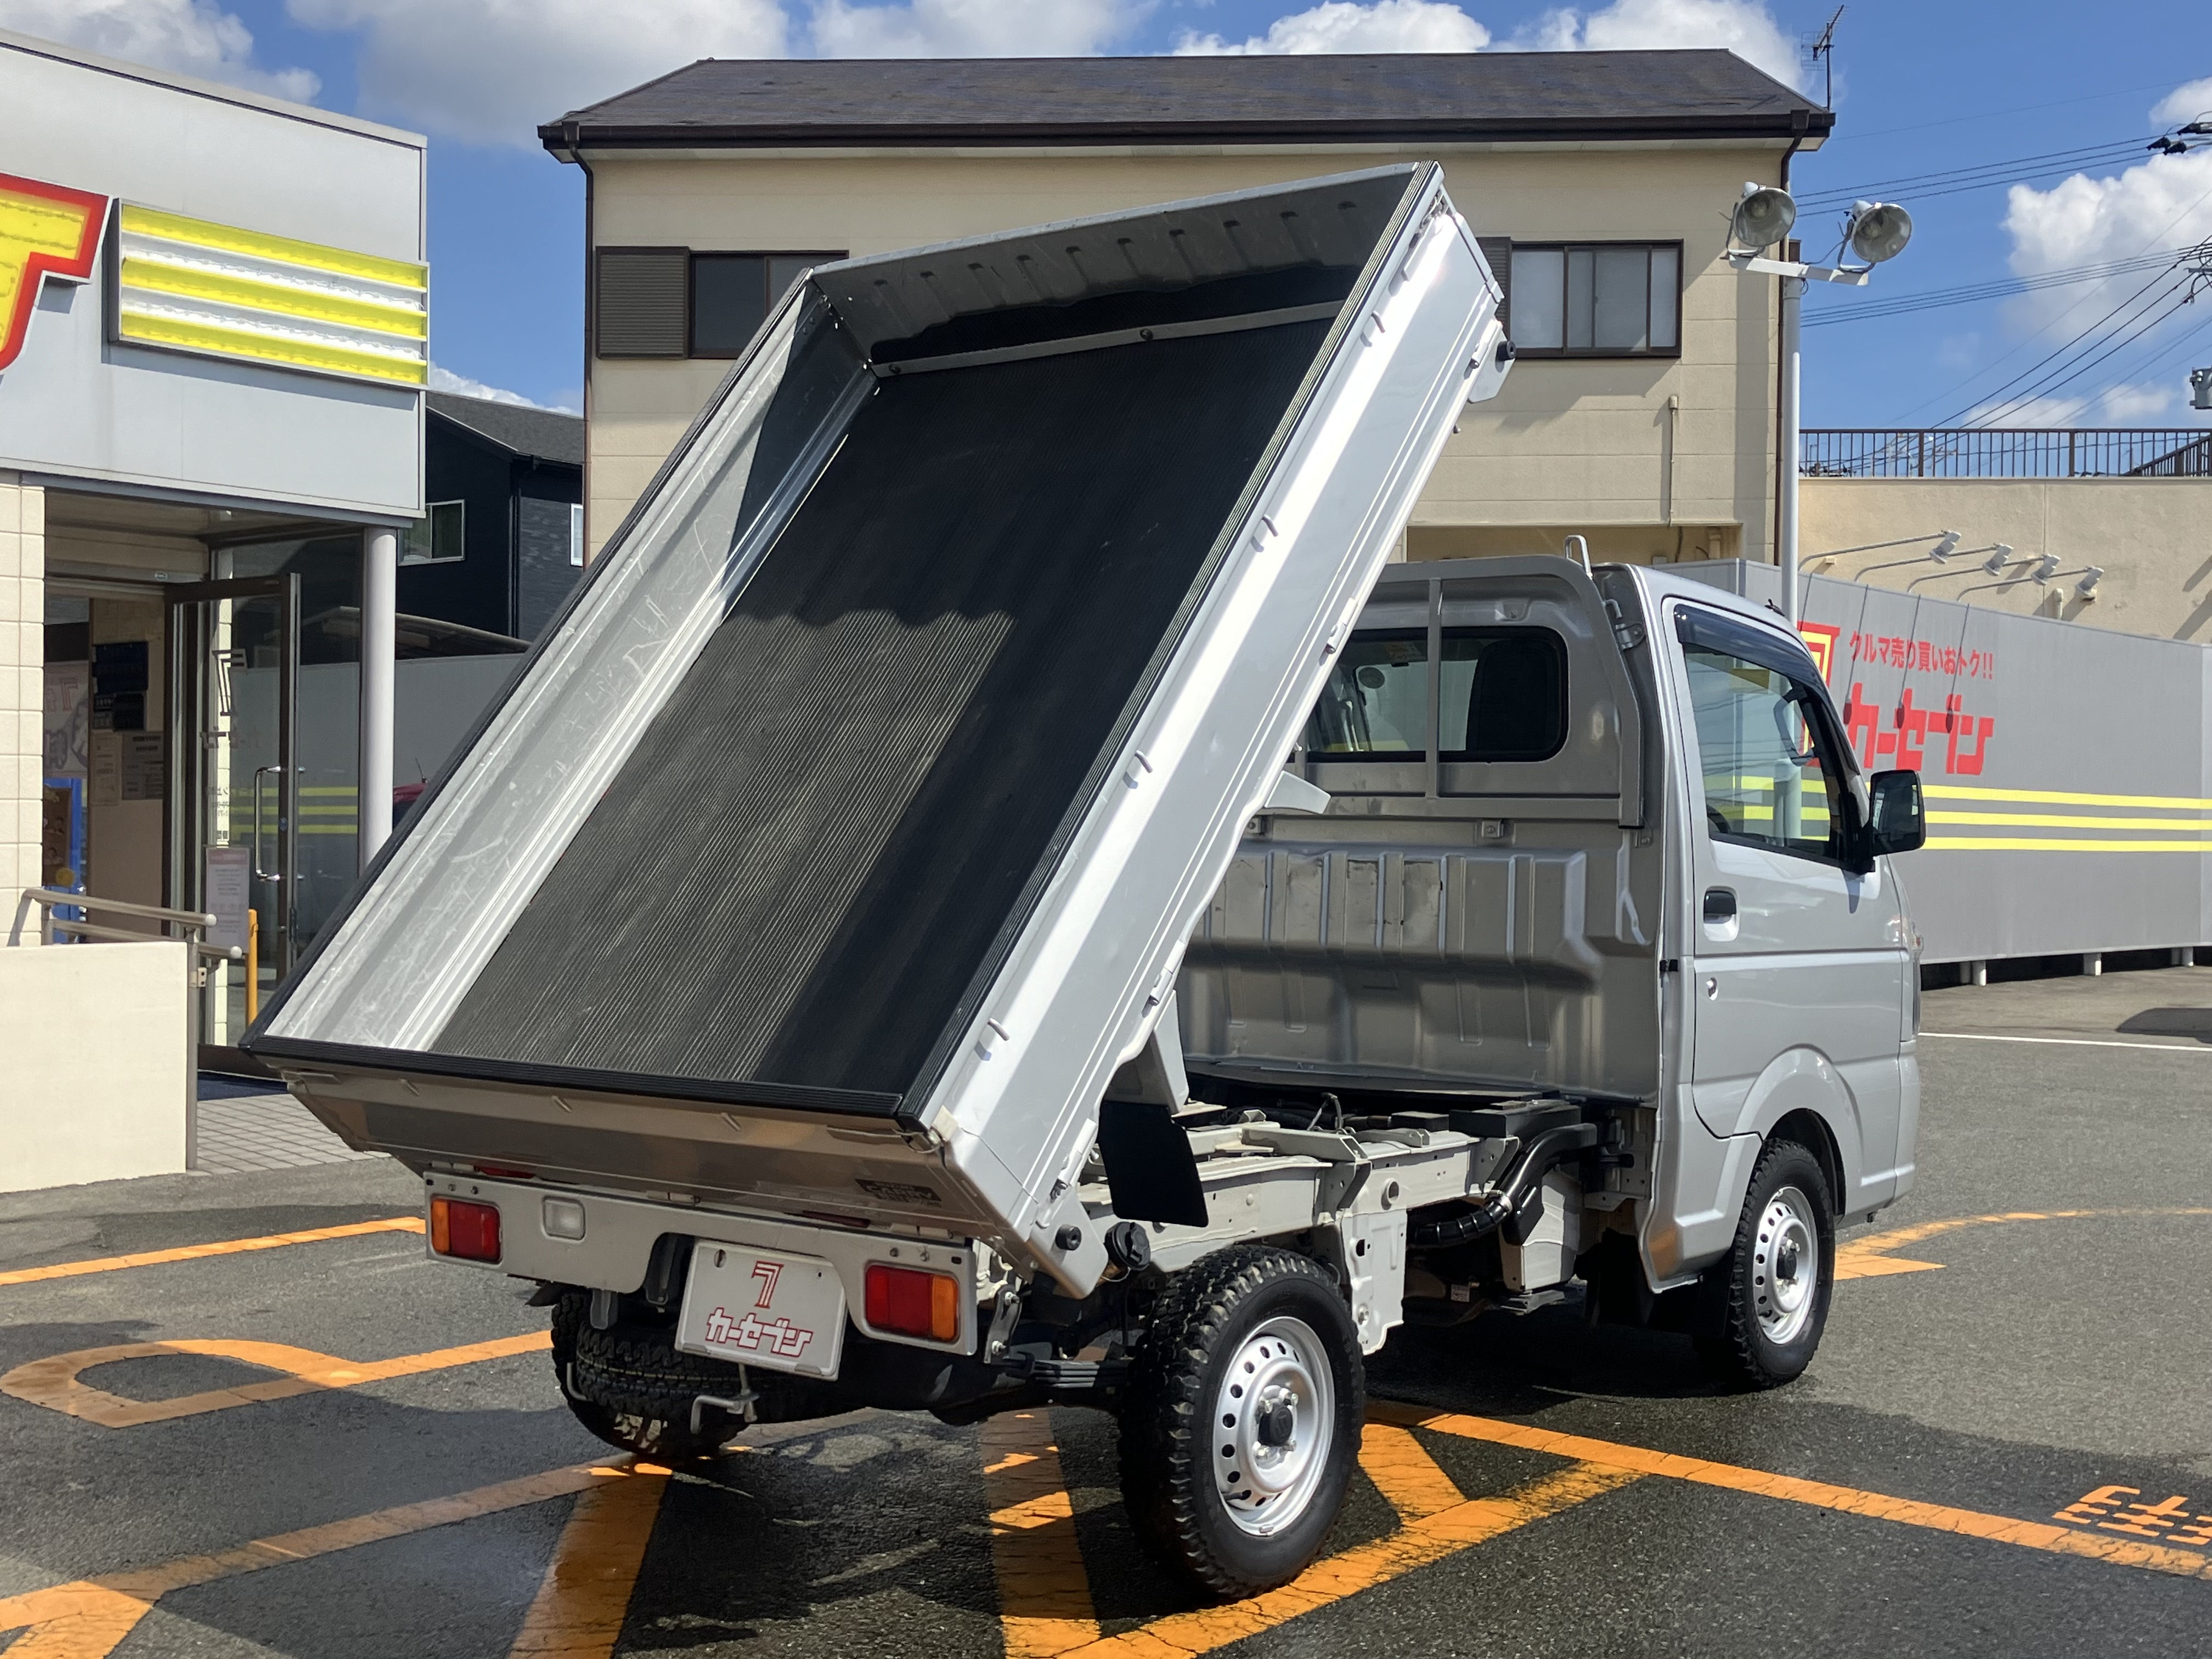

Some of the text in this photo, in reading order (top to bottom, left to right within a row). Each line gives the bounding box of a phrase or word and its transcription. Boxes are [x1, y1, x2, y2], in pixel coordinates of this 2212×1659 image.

[1844, 682, 1994, 775] カーセブン
[705, 1307, 814, 1358] カーセブン
